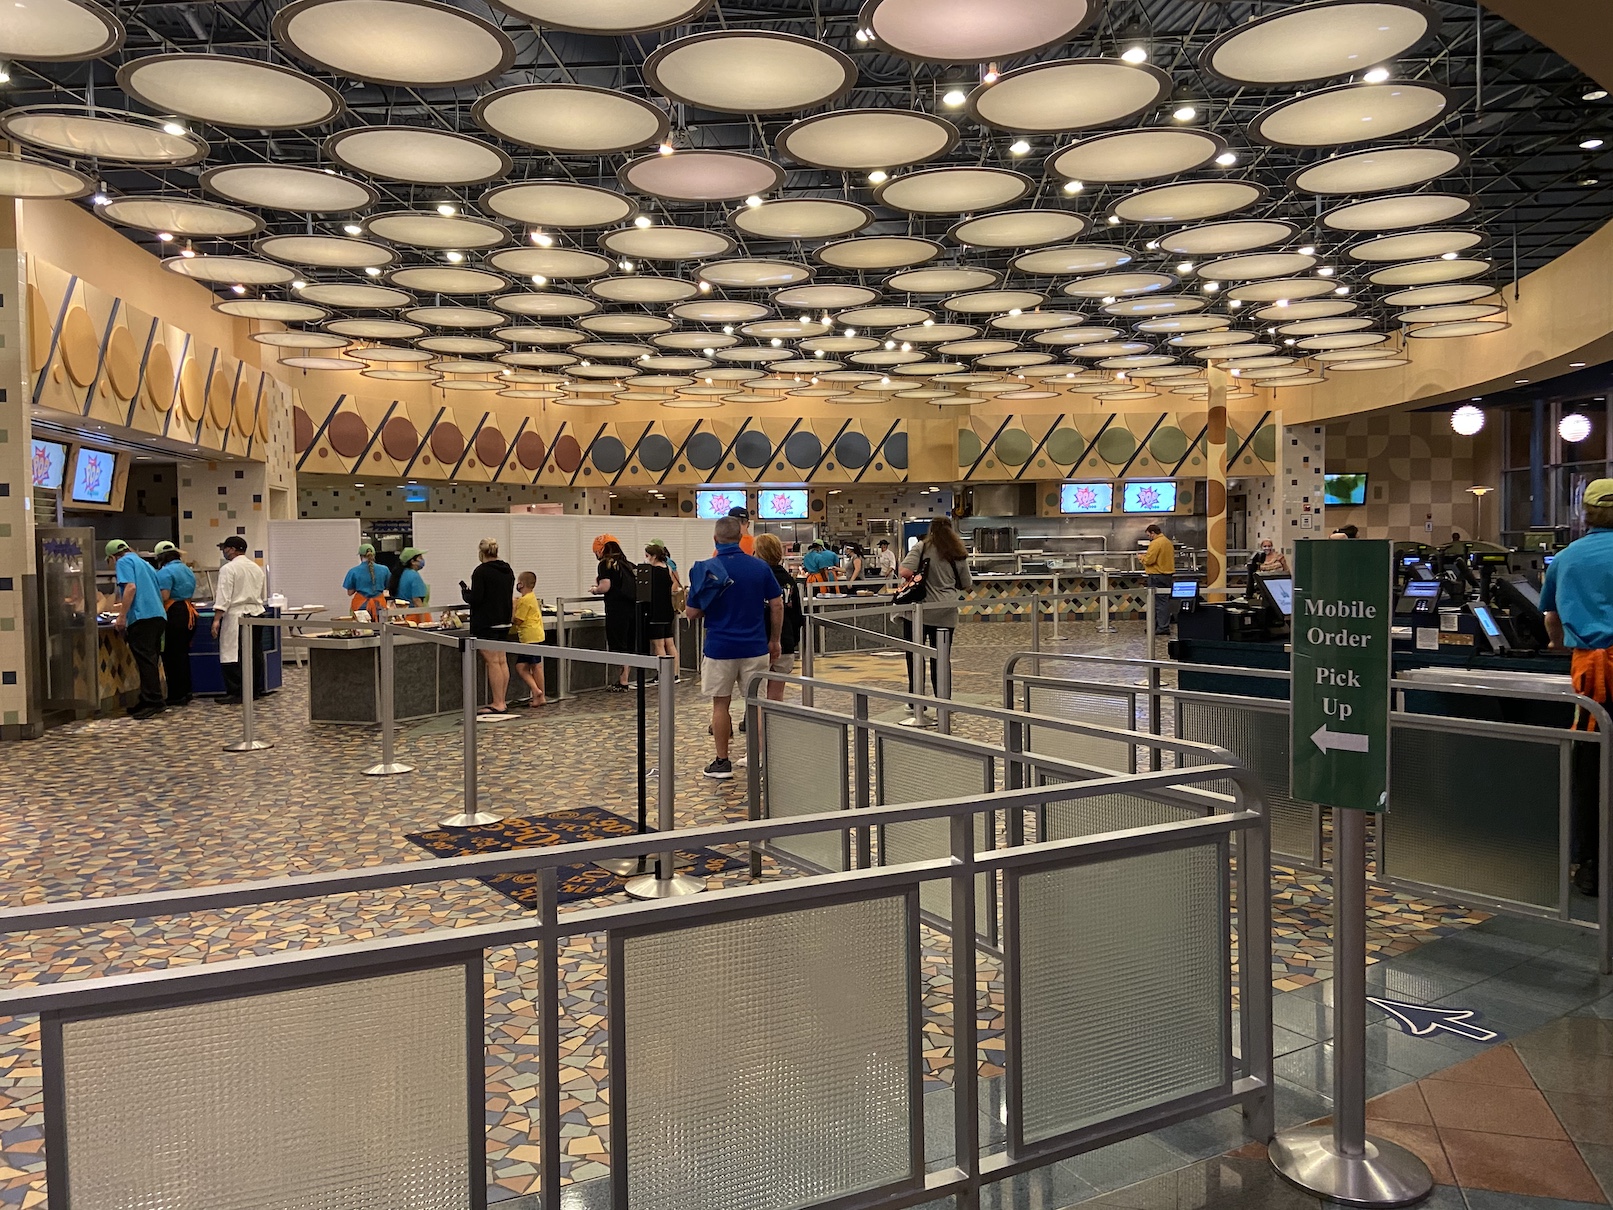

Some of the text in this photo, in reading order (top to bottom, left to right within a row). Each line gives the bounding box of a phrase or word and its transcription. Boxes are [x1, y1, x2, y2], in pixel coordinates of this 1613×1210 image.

[1304, 598, 1377, 619] Mobile
[1306, 627, 1372, 648] Order
[1315, 666, 1361, 688] Pick
[1321, 697, 1353, 721] Up
